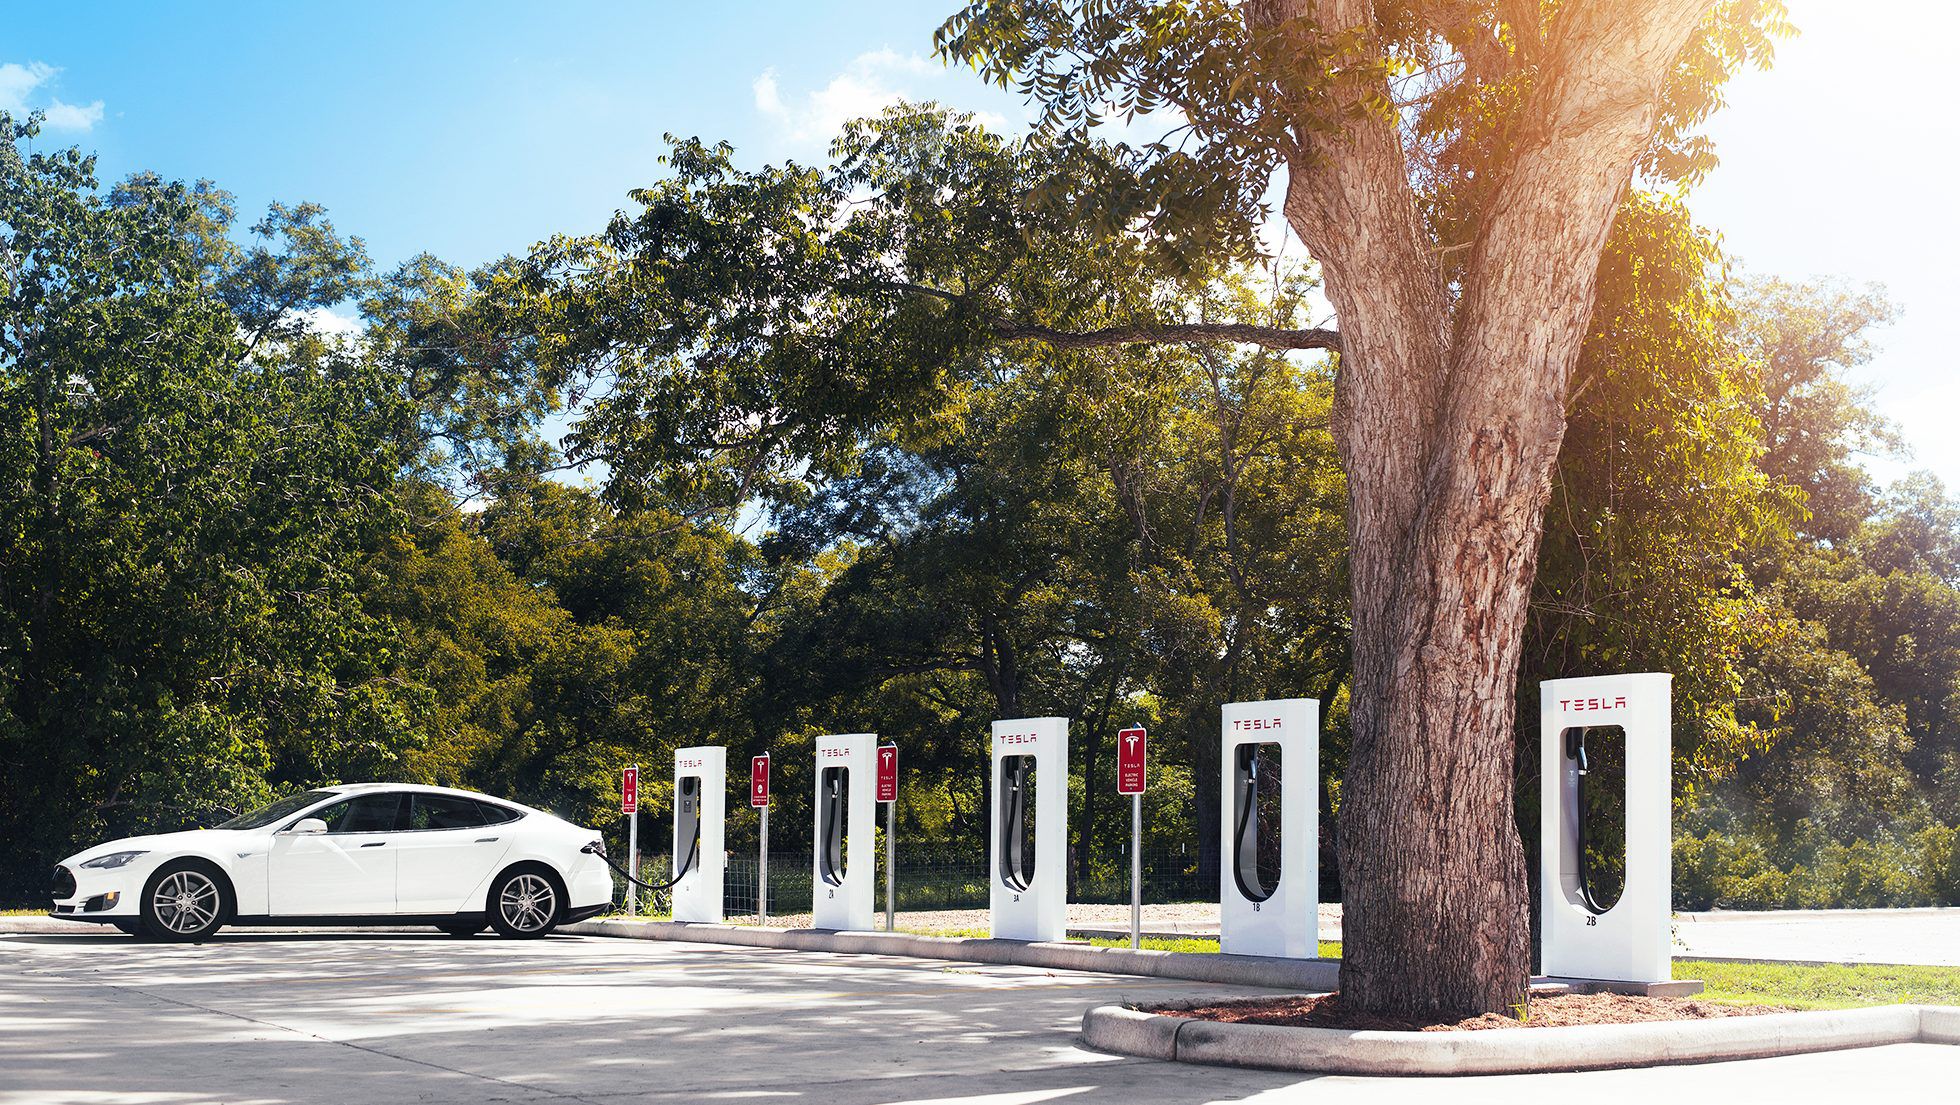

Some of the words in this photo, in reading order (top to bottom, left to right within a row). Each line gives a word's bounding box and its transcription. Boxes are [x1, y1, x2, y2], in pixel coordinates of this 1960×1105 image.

[1560, 697, 1626, 711] TESLA
[1233, 718, 1282, 730] TESLA
[1000, 733, 1037, 744] TESLA
[821, 748, 850, 757] TESLA
[679, 759, 703, 768] TESLA
[1586, 915, 1597, 926] 2B
